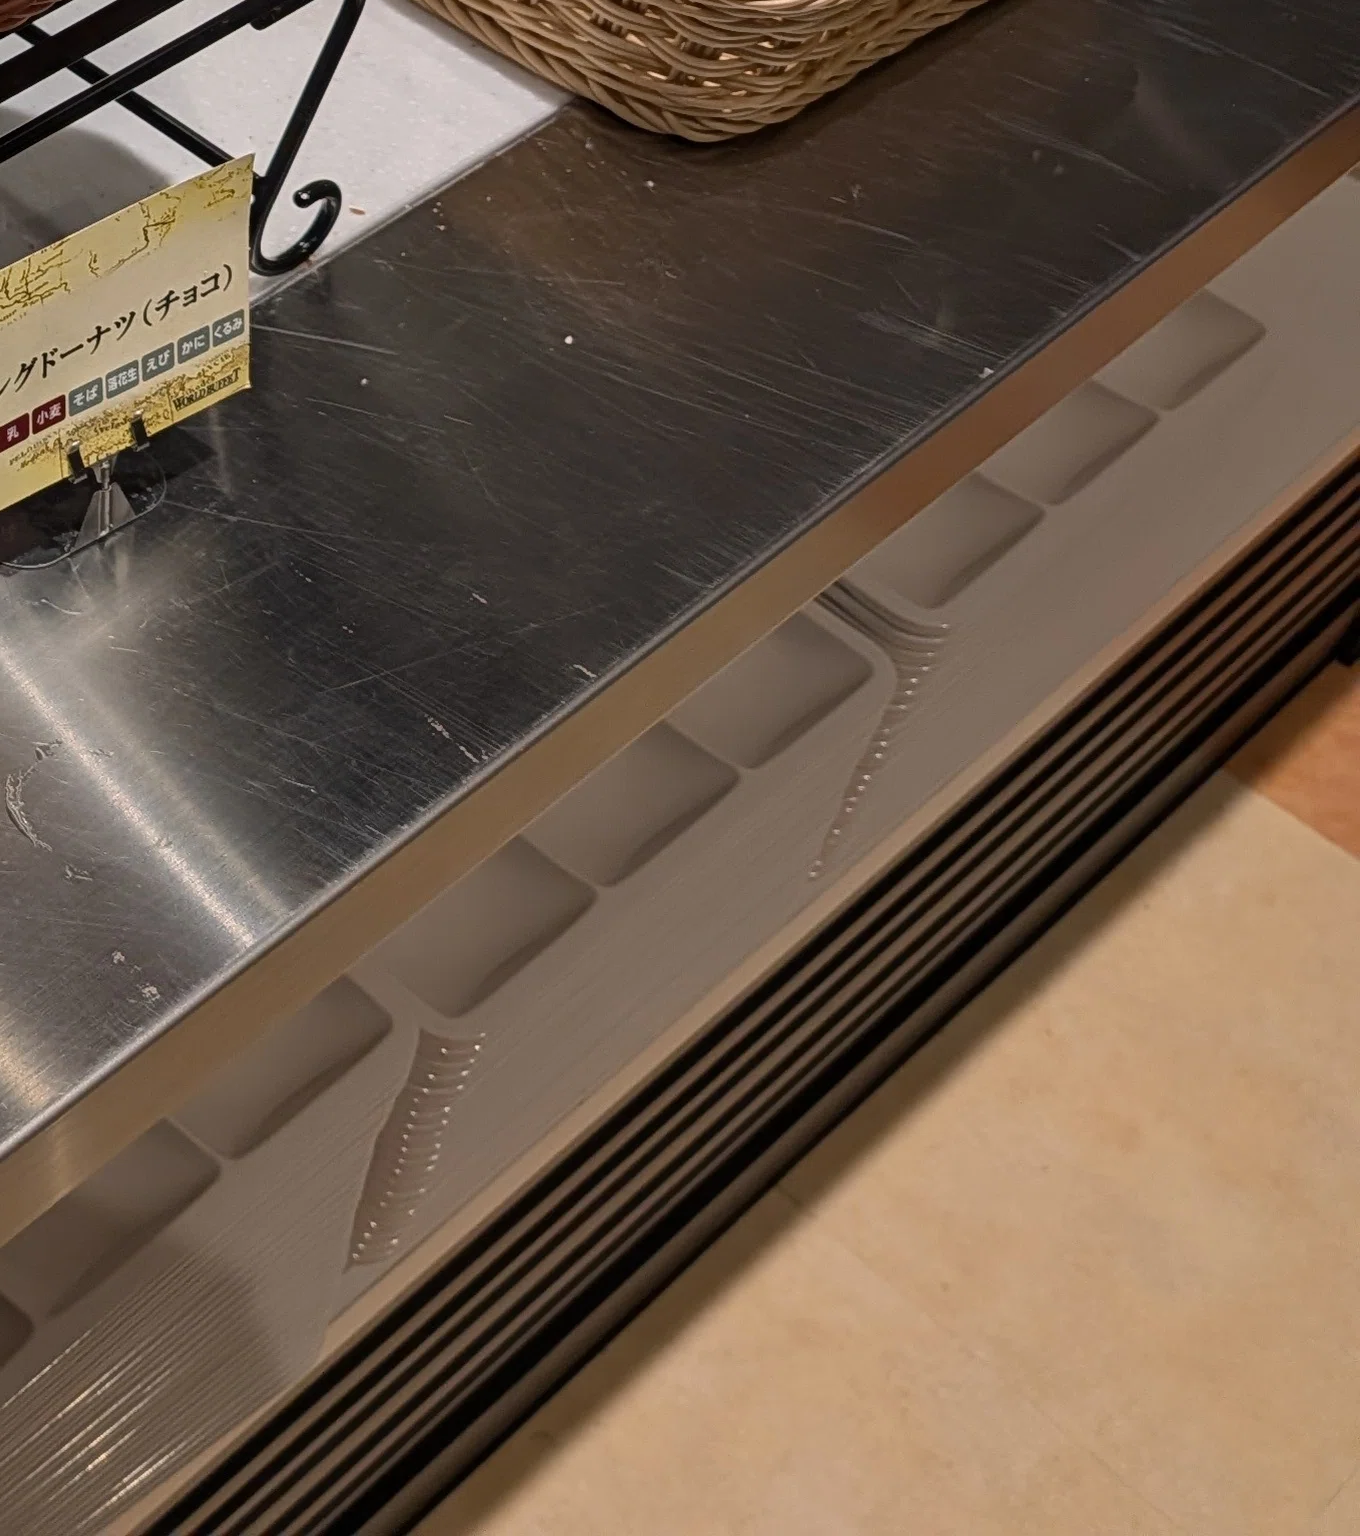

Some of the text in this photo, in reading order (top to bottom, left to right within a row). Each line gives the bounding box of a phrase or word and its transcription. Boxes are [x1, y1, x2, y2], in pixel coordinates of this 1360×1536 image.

[7, 425, 19, 442] 乳
[36, 404, 61, 426] 小麦
[73, 386, 97, 406] そば
[146, 349, 170, 372] えび
[181, 335, 205, 355] かに
[213, 318, 244, 343] くるみ
